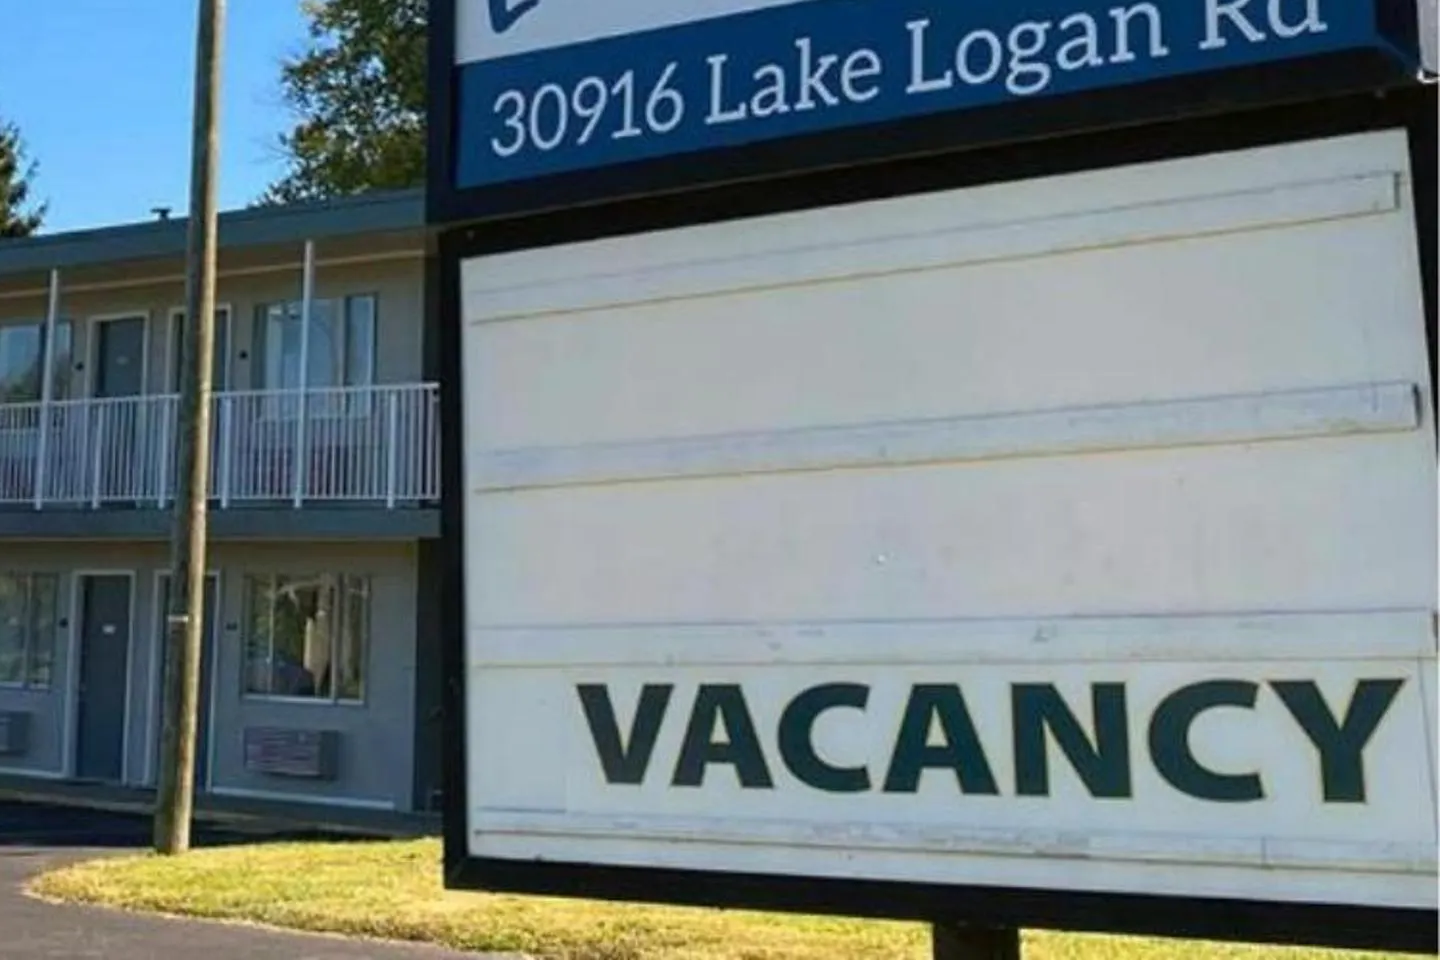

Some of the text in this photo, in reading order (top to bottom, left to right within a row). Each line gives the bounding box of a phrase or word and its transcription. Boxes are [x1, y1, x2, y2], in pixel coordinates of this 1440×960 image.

[490, 62, 682, 157] 30916
[705, 39, 882, 126] Lake
[906, 0, 1169, 96] Logan
[576, 678, 1408, 803] VACANCY
